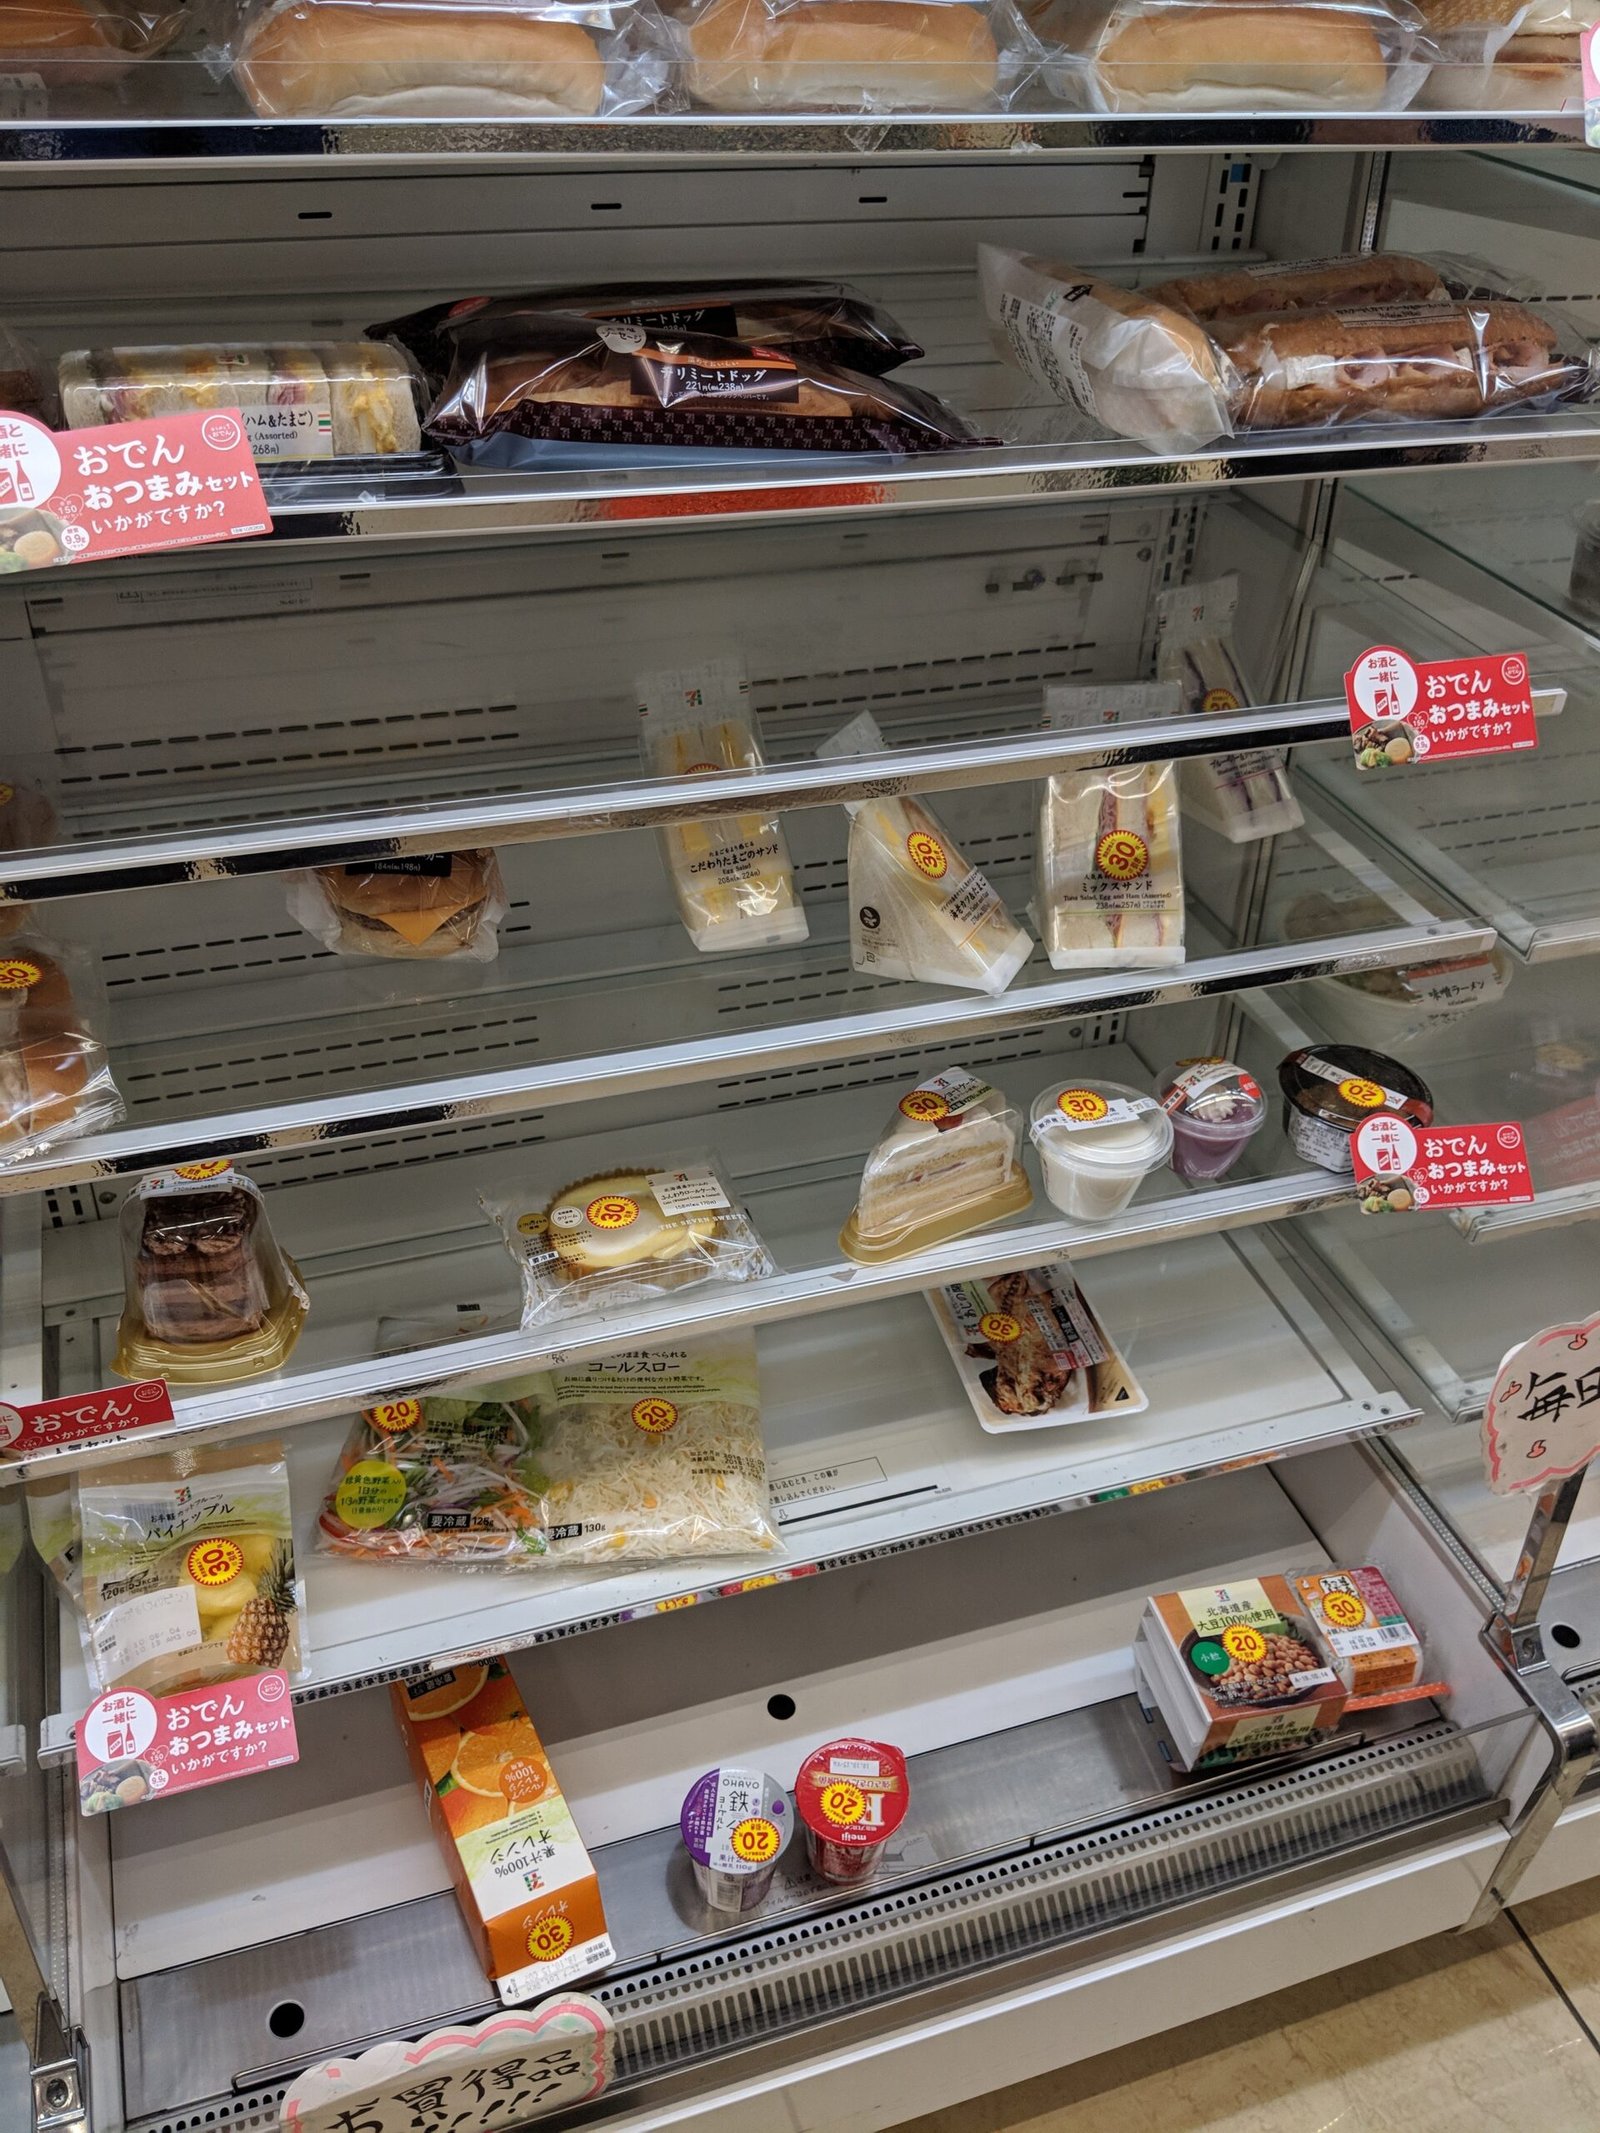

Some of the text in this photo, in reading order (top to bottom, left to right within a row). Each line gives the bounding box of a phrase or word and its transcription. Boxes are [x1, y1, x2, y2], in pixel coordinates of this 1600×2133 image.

[660, 368, 768, 382] チリミートドッグ
[73, 435, 185, 477] おでん
[83, 470, 254, 511] おつまみセット
[58, 504, 78, 515] 150
[91, 500, 226, 535] いかがですか?
[1367, 656, 1398, 670] お酒と
[1368, 671, 1400, 683] 一緒に
[1424, 670, 1492, 699] おでん
[1428, 699, 1531, 725] おつまみセット
[1431, 721, 1512, 742] いかがですか?
[690, 843, 779, 873] こだわりたまごのサンド
[917, 841, 937, 868] 30
[1108, 841, 1137, 871] 30
[1081, 880, 1153, 892] ミックスサンド
[1348, 1084, 1377, 1101] 20
[909, 1098, 939, 1114] 30
[1068, 1098, 1097, 1112] 30
[1370, 1121, 1398, 1131] お酒と
[1371, 1132, 1400, 1143] 一緒に
[1423, 1134, 1487, 1158] おでん
[1427, 1159, 1526, 1179] おつまみセット
[1431, 1178, 1508, 1195] いかがですか?
[604, 1203, 626, 1223] 30
[660, 1222, 680, 1231] THE
[681, 1215, 710, 1228] SEVEN
[988, 1318, 1014, 1337] 30
[588, 1361, 680, 1374] コールスロー
[30, 1400, 132, 1433] おでん
[383, 1401, 410, 1423] 20
[642, 1405, 668, 1426] 20
[46, 1416, 140, 1443] いかがですか?
[145, 1504, 234, 1542] パイナップル
[431, 1515, 468, 1527] 要冷蔵
[585, 1523, 606, 1533] 130g
[202, 1548, 230, 1577] 30
[1207, 1600, 1253, 1617] 北海道産
[1331, 1600, 1356, 1618] 30
[1196, 1608, 1278, 1631] 大豆100%使用
[1231, 1635, 1257, 1651] 20
[1200, 1652, 1222, 1663] 小粒
[102, 1696, 135, 1713] お酒と
[166, 1694, 245, 1731] おでん
[102, 1710, 136, 1725] 一緒に
[169, 1715, 290, 1757] おつまみセット
[171, 1740, 267, 1775] いかがですか?
[505, 1765, 534, 1782] 100%
[508, 1775, 541, 1792] オレンジ
[722, 1778, 760, 1790] OHAYO
[728, 1790, 749, 1813] 鉄
[830, 1792, 858, 1816] 20
[716, 1796, 727, 1831] ヨーグルト
[489, 1828, 552, 1865] オレンジ
[742, 1832, 769, 1850] 20
[841, 1833, 867, 1841] meiji
[494, 1844, 555, 1878] 果汁100%
[522, 1900, 569, 1929] オレンジ
[536, 1924, 566, 1950] 30
[324, 2049, 580, 2133] お買得品
